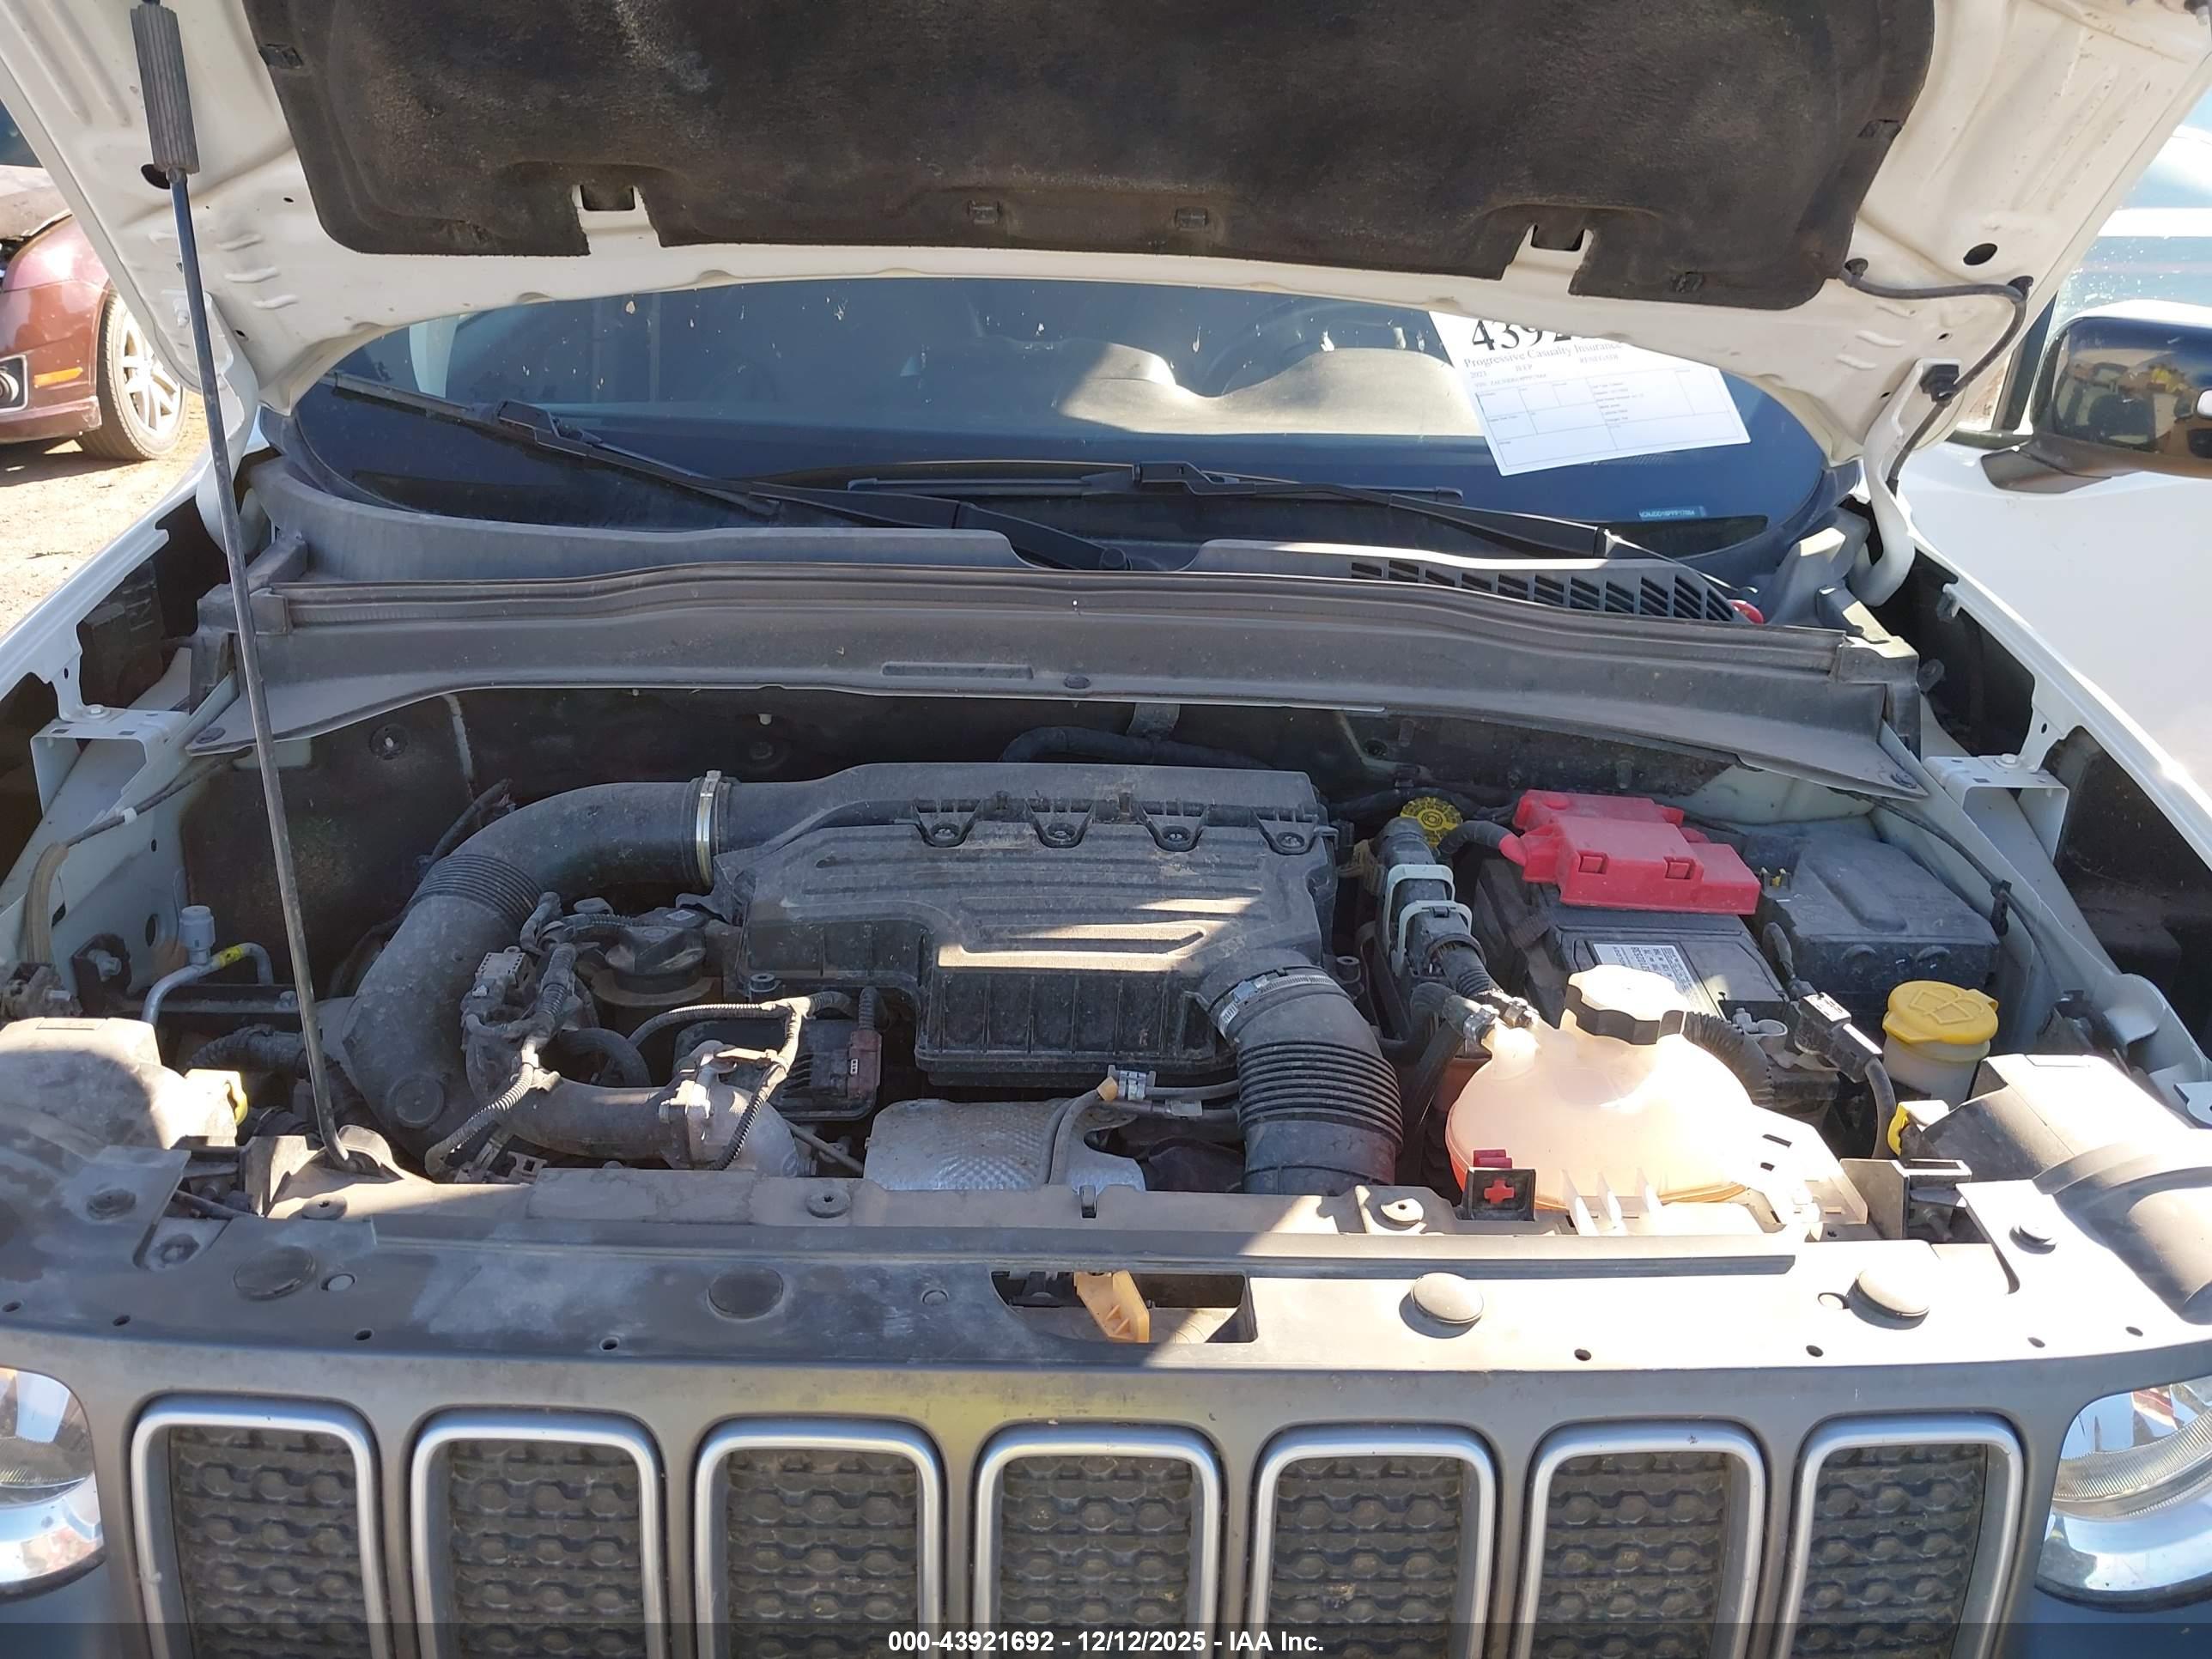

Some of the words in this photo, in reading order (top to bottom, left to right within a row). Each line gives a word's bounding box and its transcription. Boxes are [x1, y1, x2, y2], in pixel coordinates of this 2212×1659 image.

[1463, 352, 1526, 368] Progressive
[1528, 345, 1572, 359] Casualty
[1574, 343, 1622, 353] Insurance
